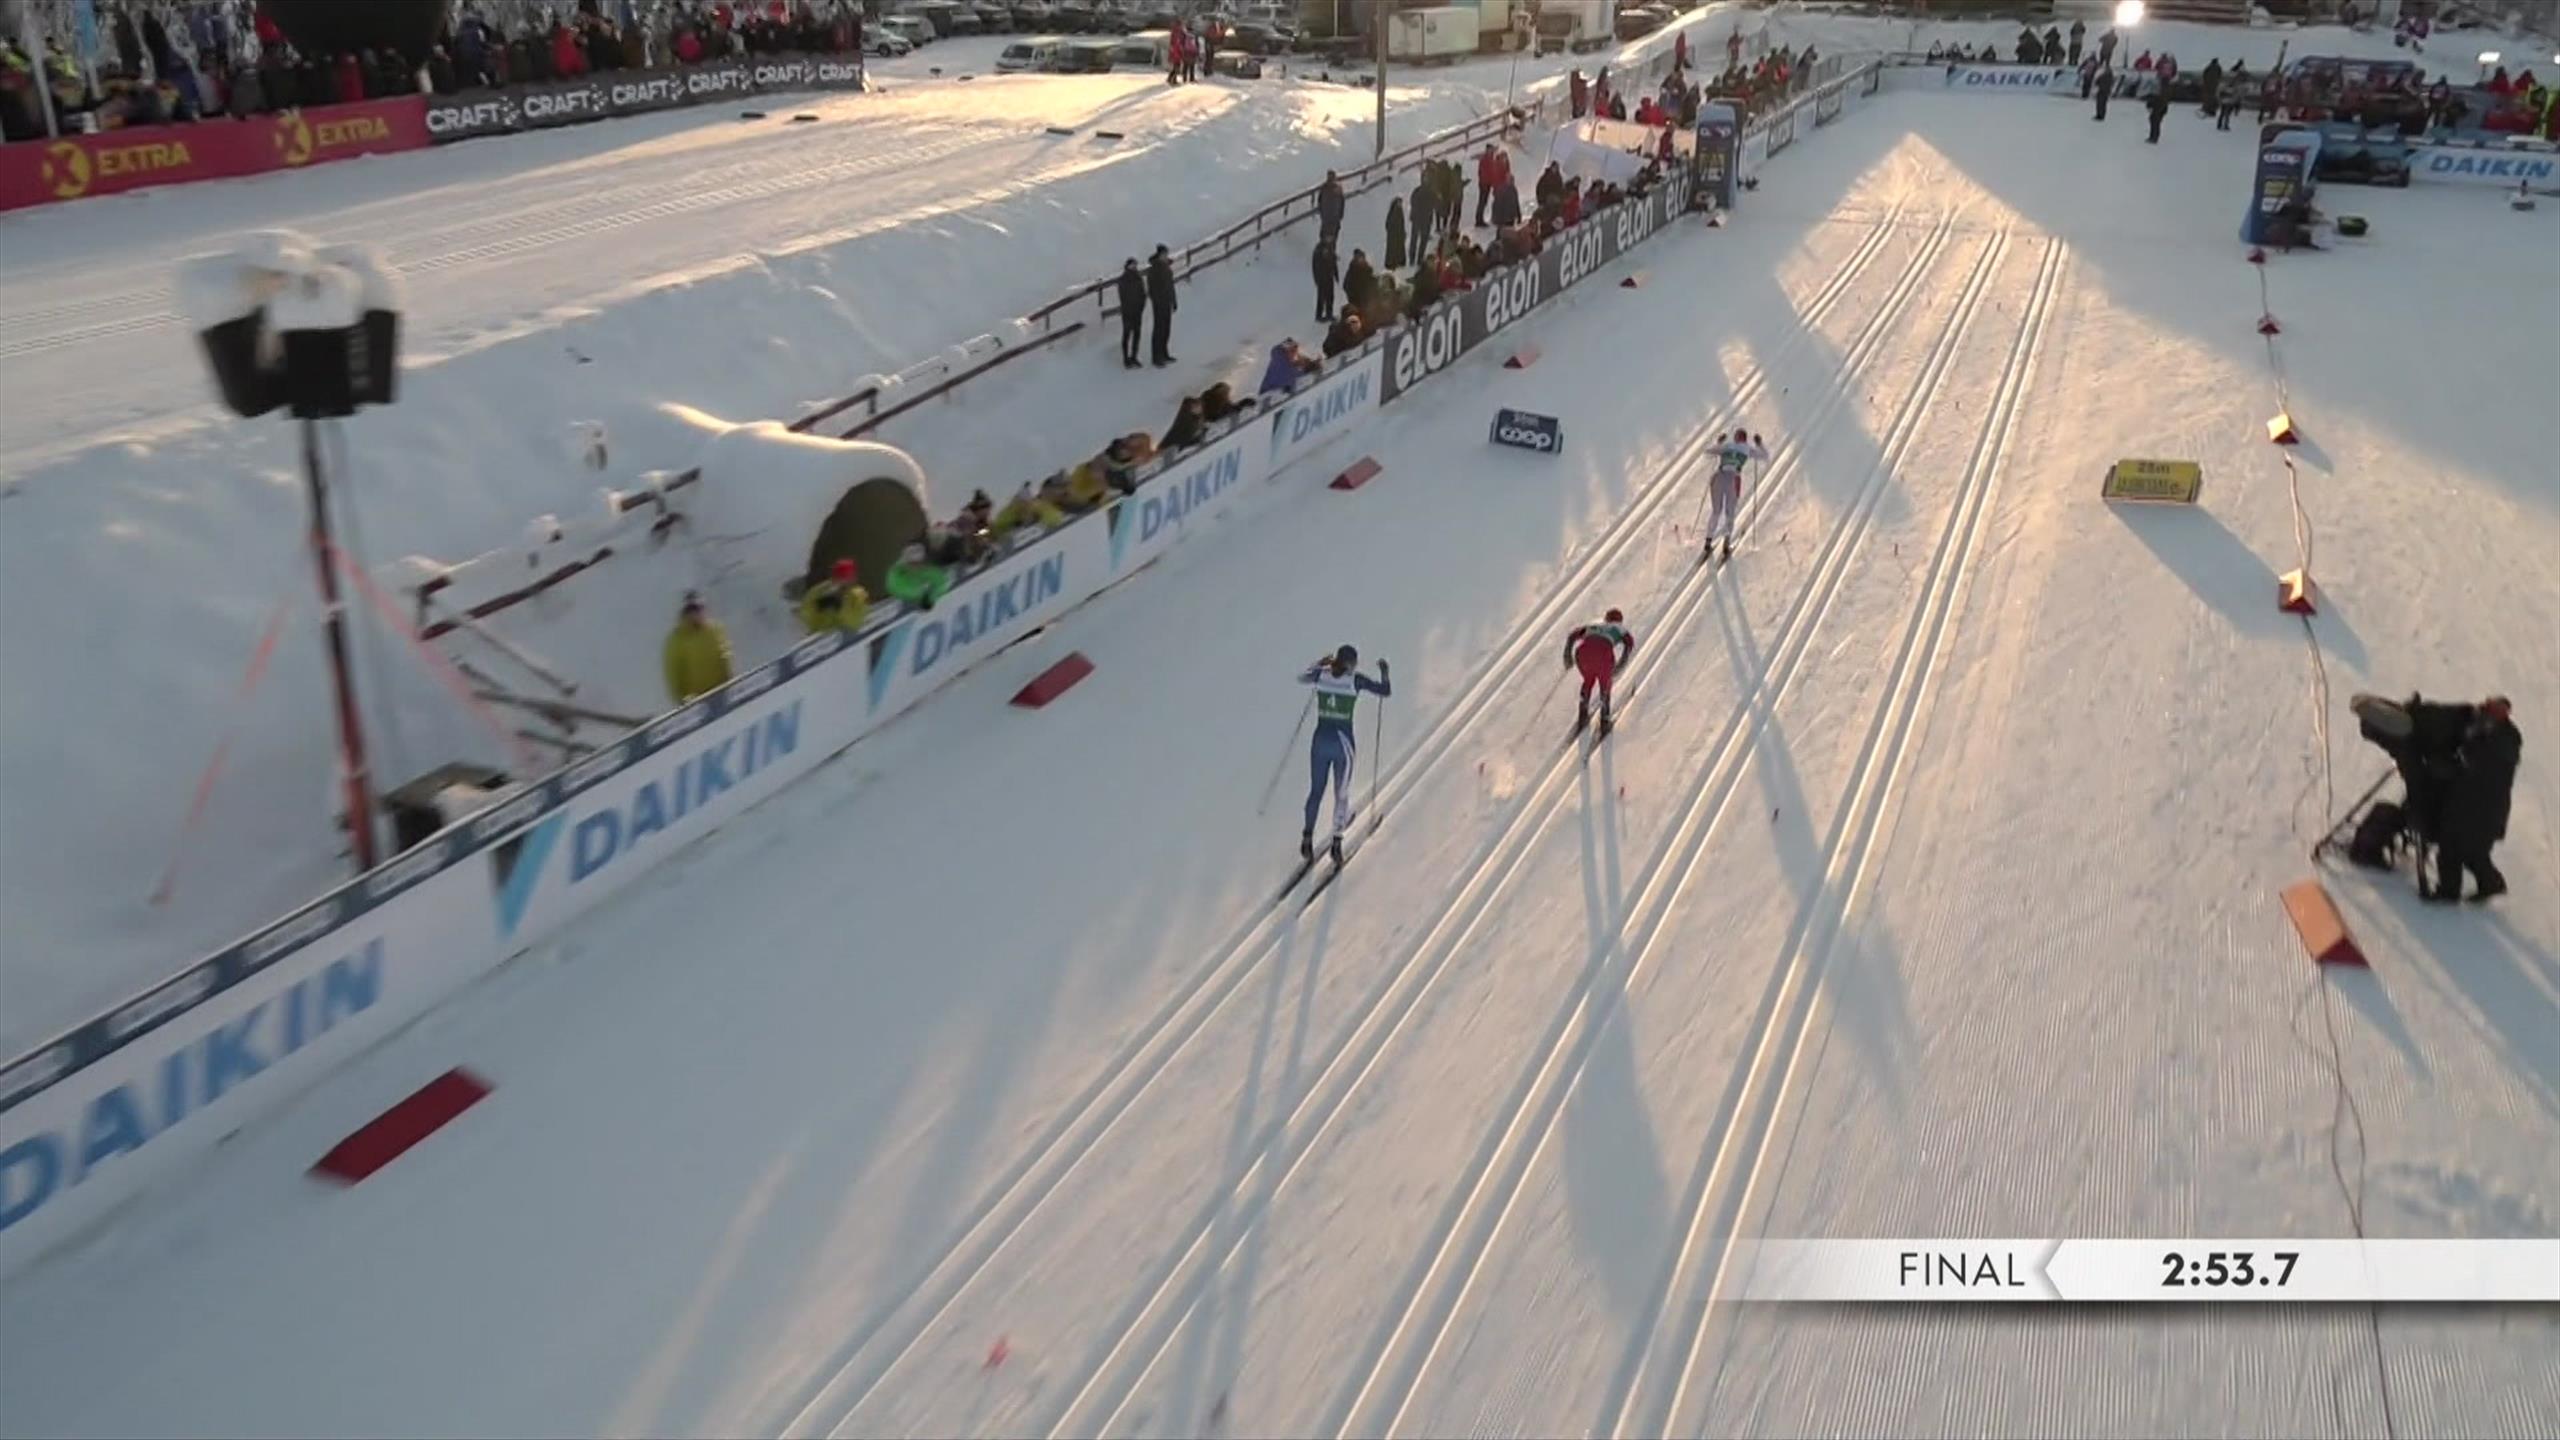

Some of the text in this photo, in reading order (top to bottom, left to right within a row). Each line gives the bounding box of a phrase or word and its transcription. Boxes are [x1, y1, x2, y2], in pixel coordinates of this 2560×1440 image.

[688, 71, 738, 93] CRAFT
[755, 65, 803, 84] CRAFT
[819, 64, 861, 80] CRAFT
[1966, 71, 2049, 86] DAIKIN
[524, 90, 590, 117] CRAFT
[612, 79, 668, 105] CRAFT
[317, 117, 390, 147] EXTRA
[426, 103, 500, 132] CRAFT
[99, 142, 190, 175] EXTRA
[2430, 155, 2553, 177] DAIKIN
[1666, 176, 1692, 221] elo
[1292, 368, 1371, 443] DAIKIN
[1499, 425, 1551, 450] coop
[1141, 446, 1242, 543] DAIKIN
[911, 551, 1064, 676] DAIKIN
[570, 700, 800, 885] DAIKIN
[0, 935, 385, 1232] DAIKIN
